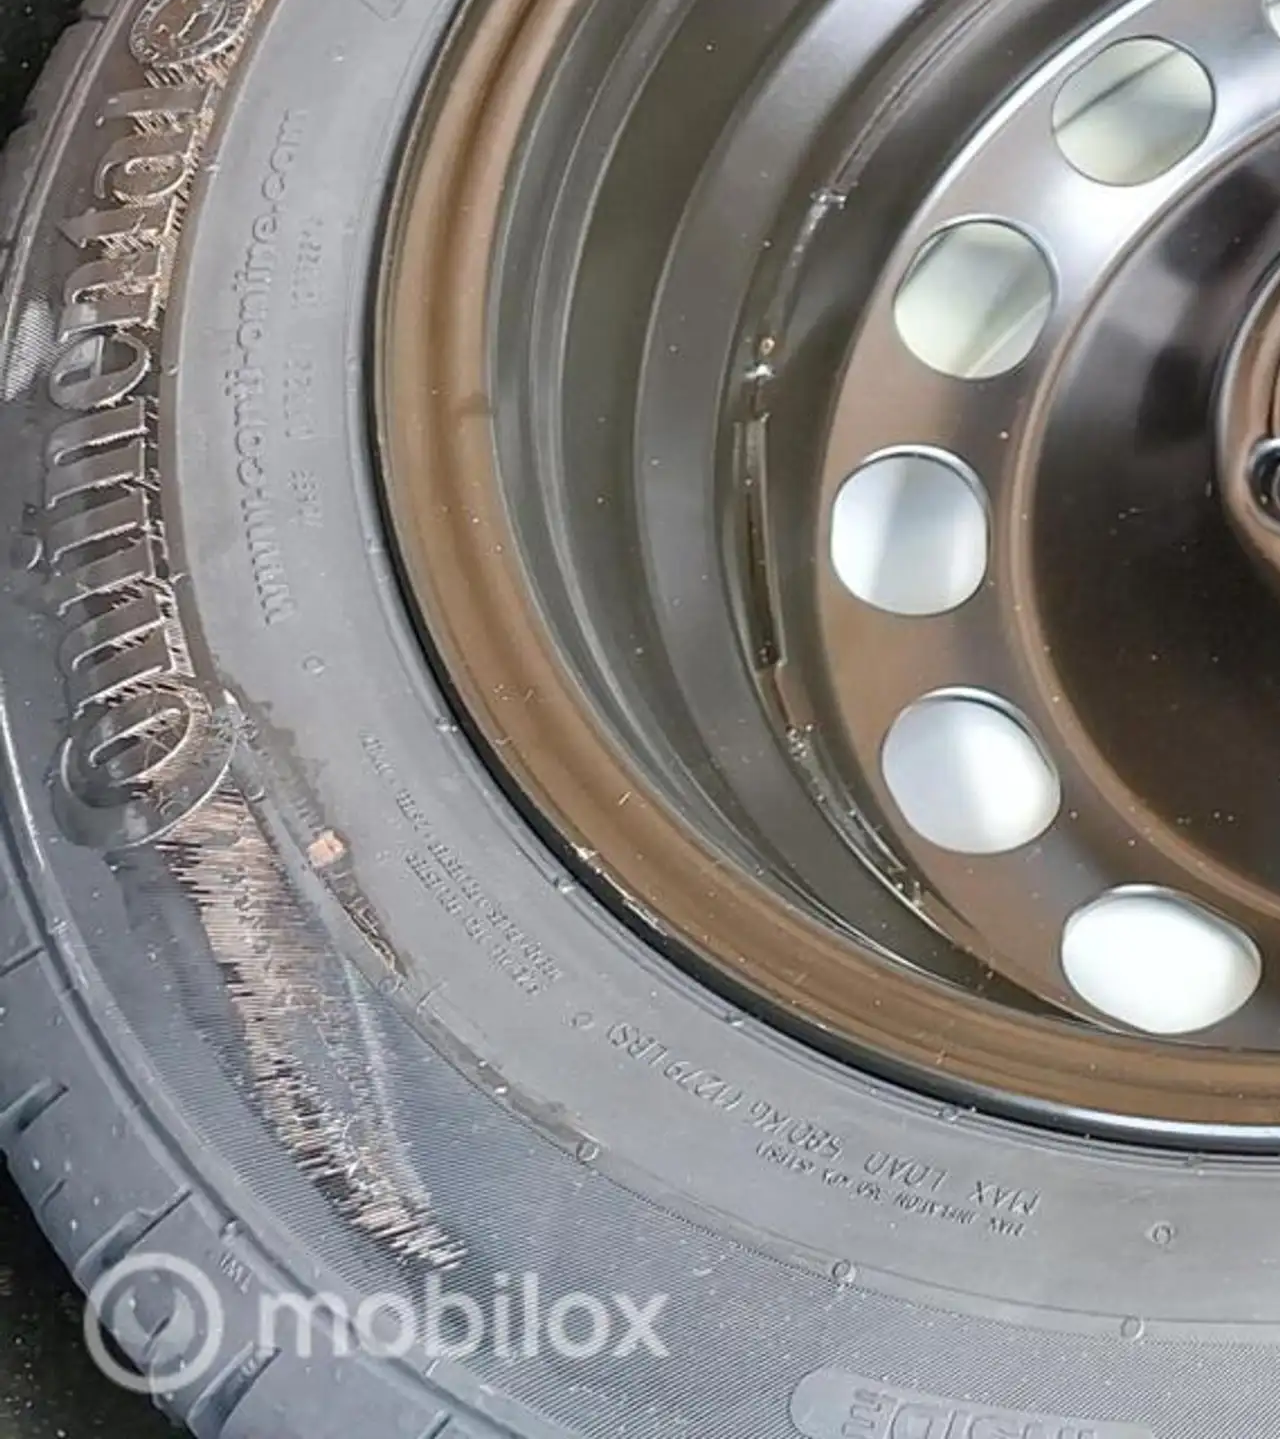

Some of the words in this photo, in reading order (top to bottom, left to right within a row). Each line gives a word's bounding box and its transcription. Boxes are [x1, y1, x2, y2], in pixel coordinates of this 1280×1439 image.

[214, 109, 310, 625] www.conti-online.com
[862, 1149, 950, 1194] LOAD
[969, 1179, 1041, 1218] MAX
